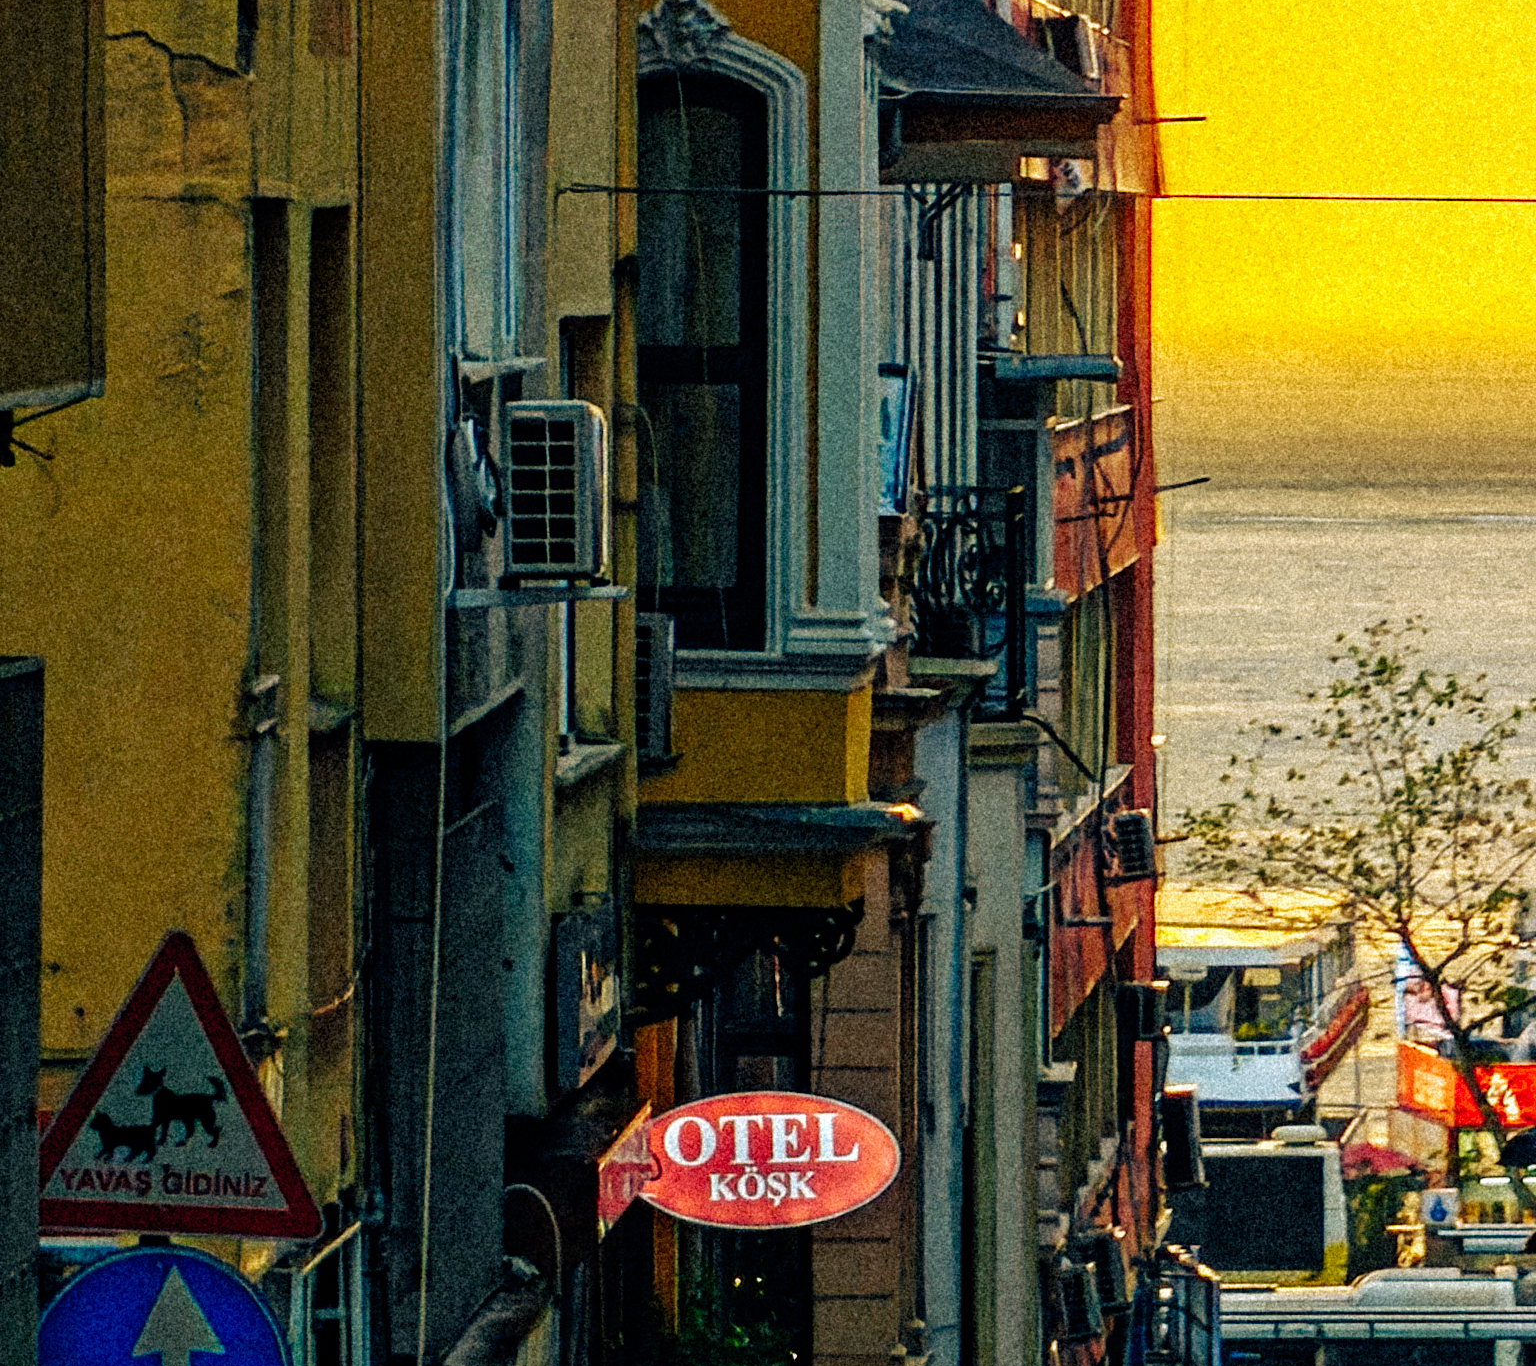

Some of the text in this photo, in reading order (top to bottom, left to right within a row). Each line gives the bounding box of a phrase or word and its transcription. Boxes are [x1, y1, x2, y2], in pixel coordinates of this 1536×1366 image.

[663, 1112, 860, 1167] OTEL
[60, 1167, 152, 1197] YAVAŞ
[709, 1165, 818, 1207] KÖŞK
